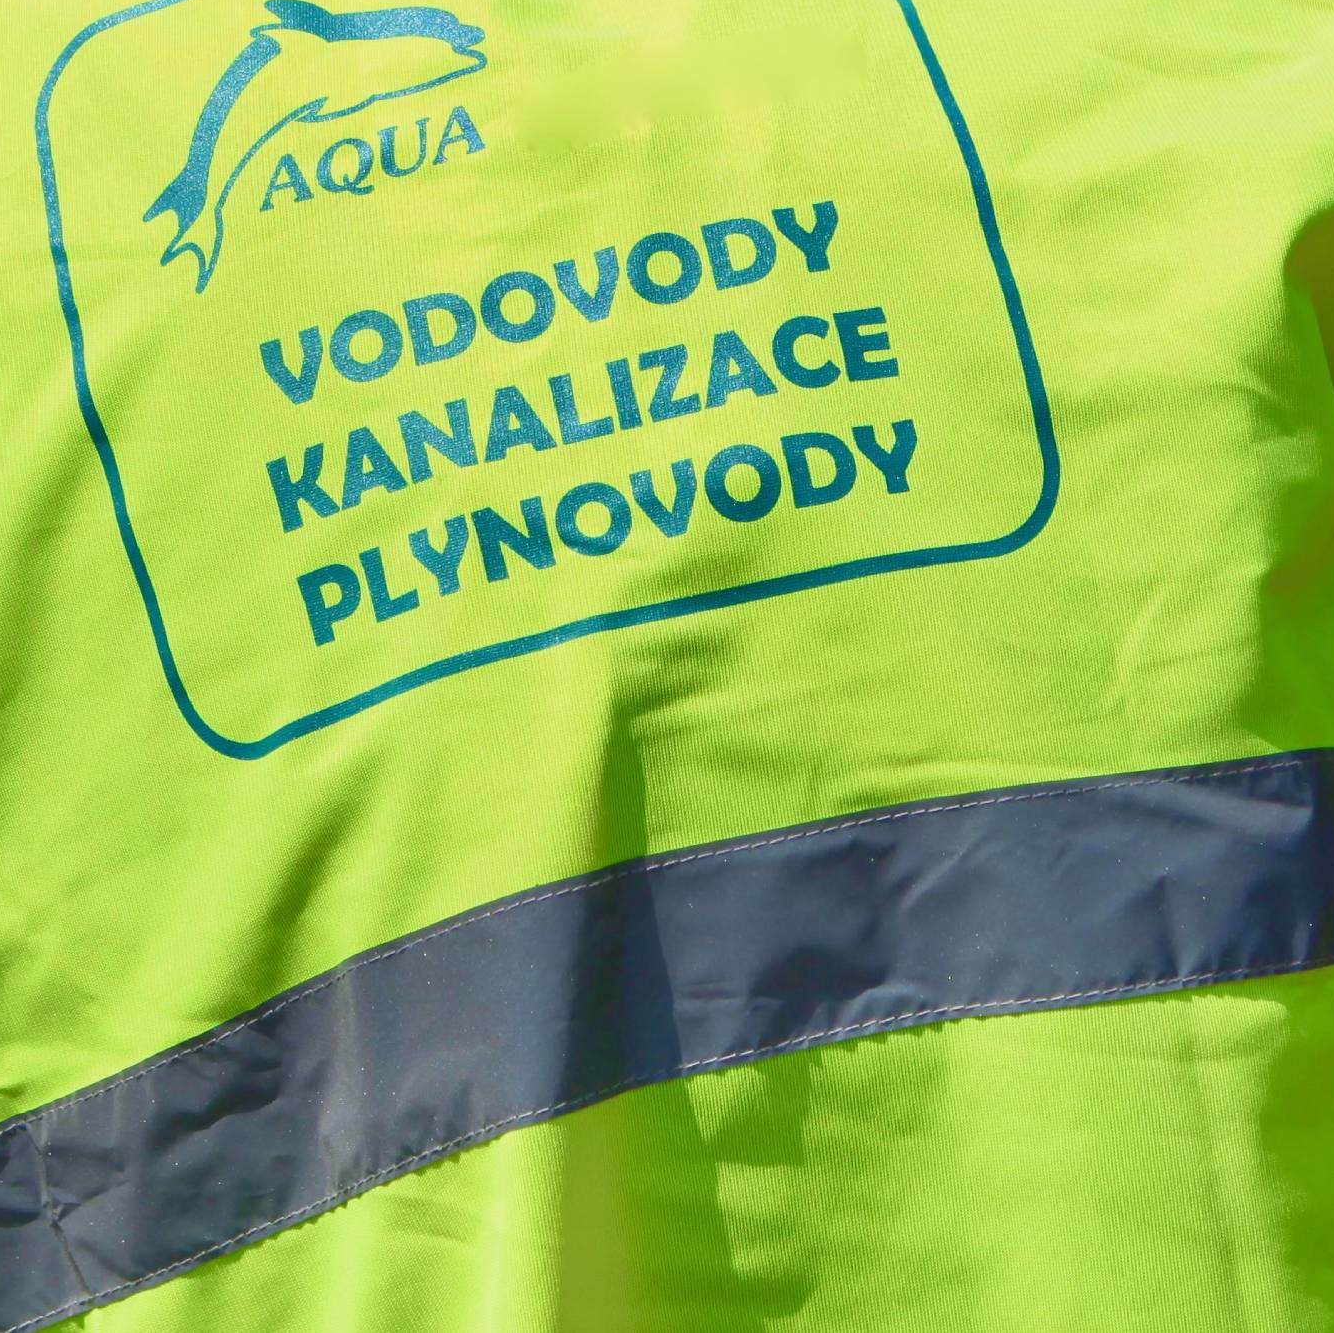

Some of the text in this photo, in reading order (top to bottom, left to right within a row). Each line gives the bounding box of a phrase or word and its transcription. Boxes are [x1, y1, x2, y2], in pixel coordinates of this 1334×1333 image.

[260, 106, 486, 212] AQUA
[262, 201, 839, 404] VODOVODY
[267, 307, 898, 532] KANALIZACE
[298, 421, 917, 644] PLYNOVODY
